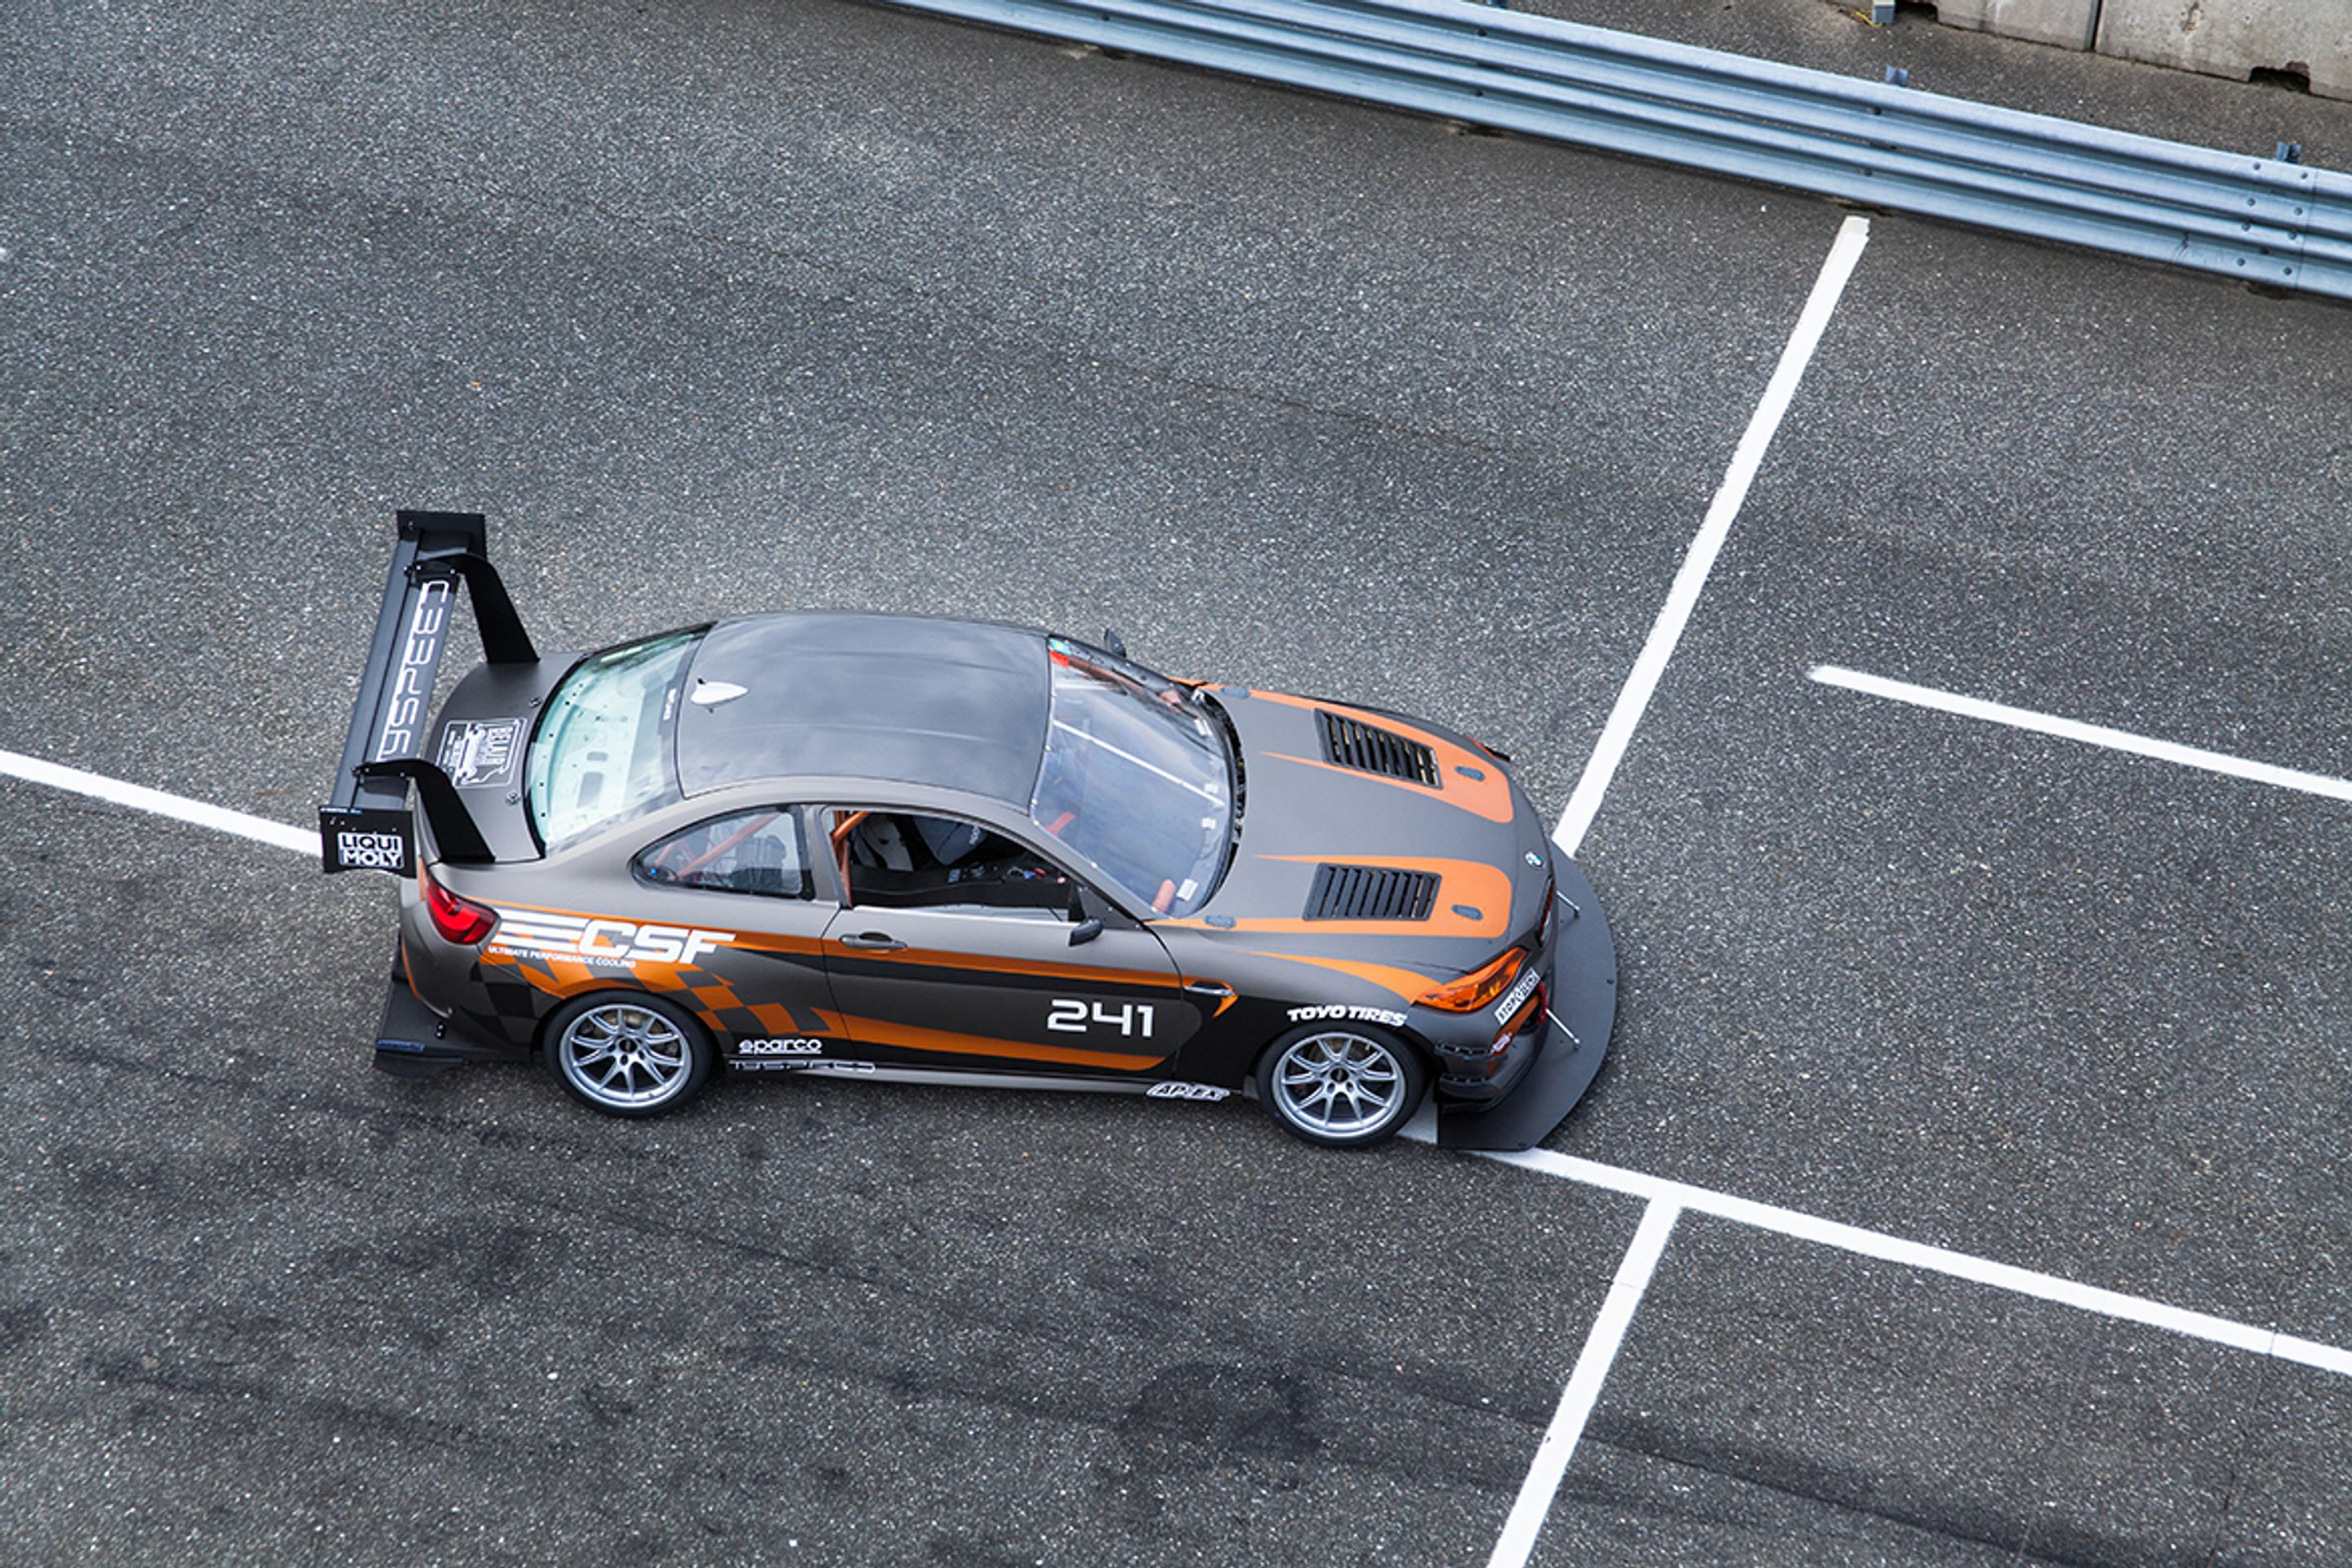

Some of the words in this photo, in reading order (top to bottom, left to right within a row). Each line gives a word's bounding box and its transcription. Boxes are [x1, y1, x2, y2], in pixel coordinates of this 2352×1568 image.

[342, 834, 398, 850] LIQUI
[344, 850, 401, 866] MOLY
[579, 919, 737, 964] CSF
[488, 947, 528, 959] ULTIMATE
[530, 950, 595, 966] PERFORMANCE
[595, 958, 636, 968] COOLING
[1047, 999, 1154, 1037] 241
[1287, 1005, 1347, 1021] TOYO
[1348, 1005, 1407, 1027] TIRES
